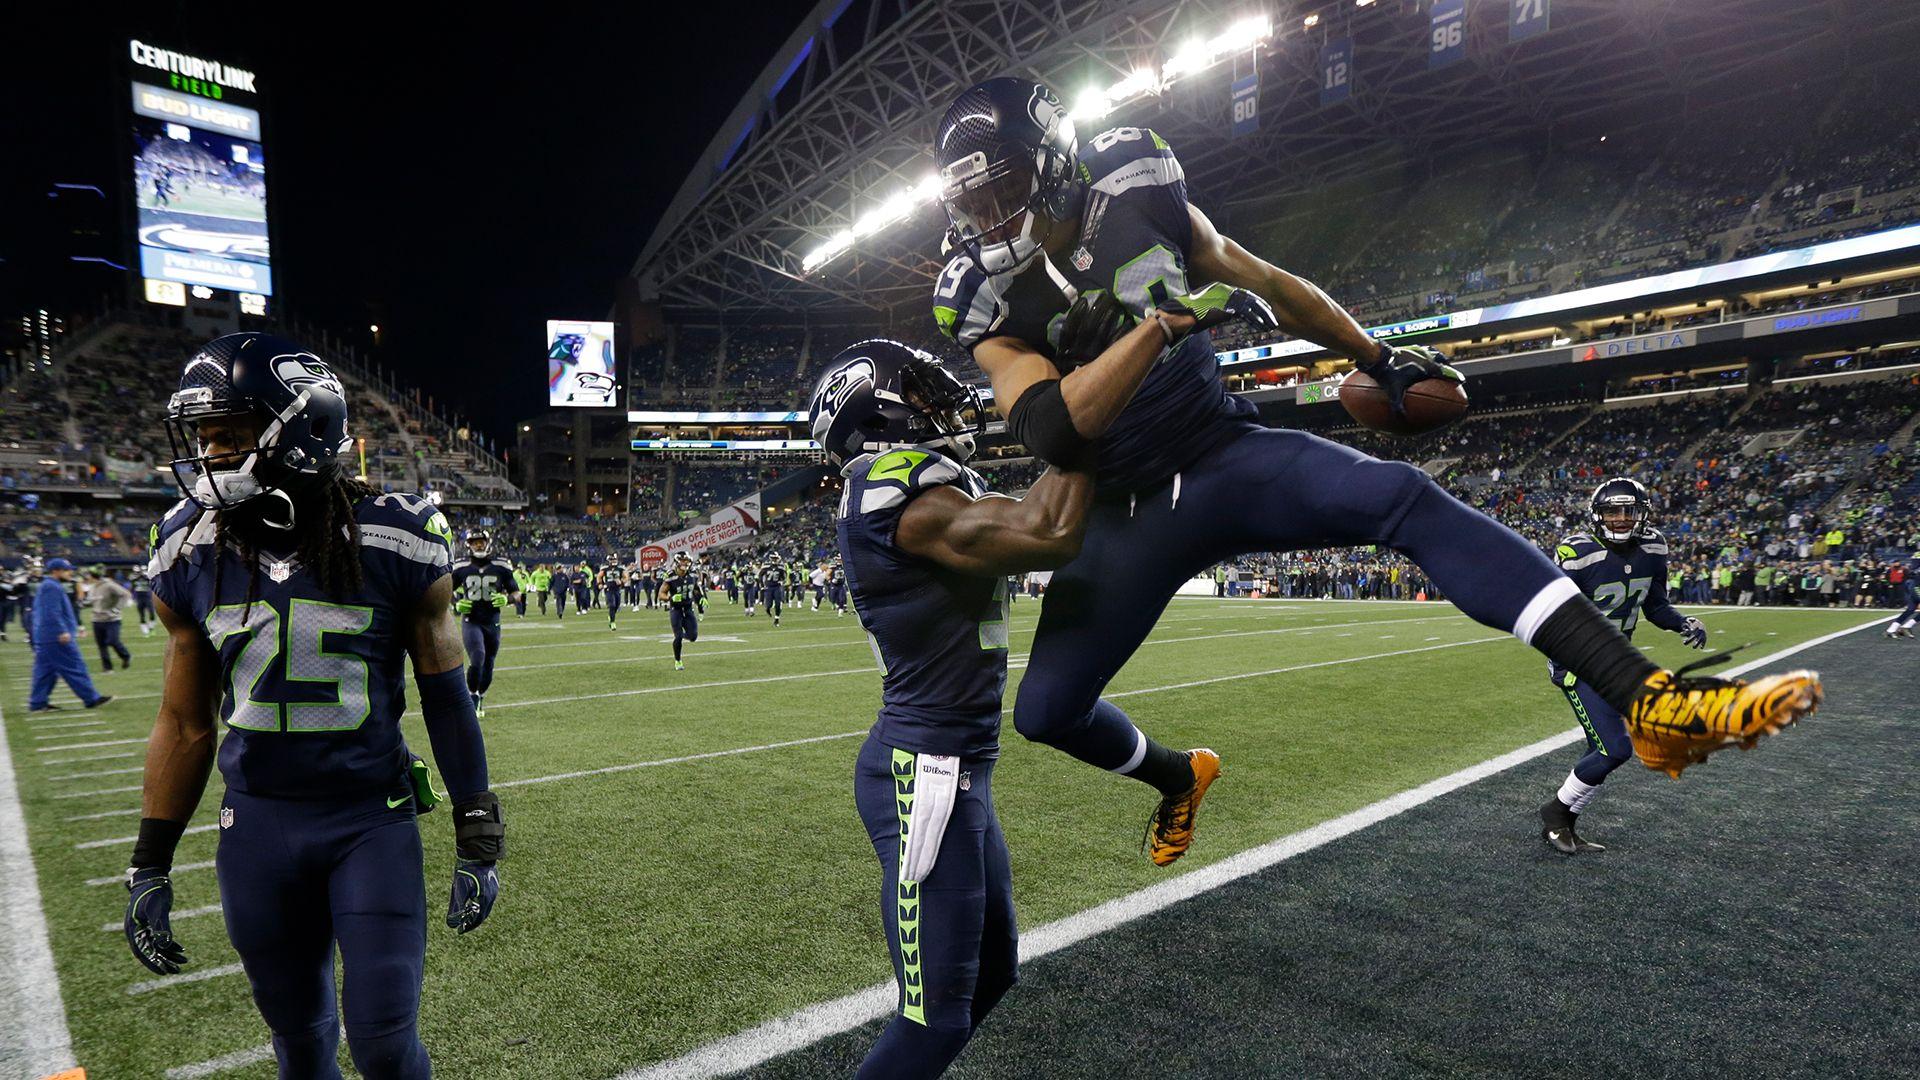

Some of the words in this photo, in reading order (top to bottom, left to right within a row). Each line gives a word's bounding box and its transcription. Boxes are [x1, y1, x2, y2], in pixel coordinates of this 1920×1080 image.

[1433, 21, 1462, 52] 96
[130, 39, 257, 94] CENTURYLINK
[1325, 62, 1347, 90] 12
[170, 73, 222, 100] FIELD
[142, 92, 190, 117] BUD
[190, 103, 252, 131] LIGHT
[1234, 97, 1256, 123] 80
[1115, 168, 1157, 184] SEAHAWKS
[1608, 334, 1684, 356] DELTA
[362, 531, 410, 547] SEAHAWKS
[667, 536, 688, 552] KICK
[688, 530, 704, 542] OFF
[706, 519, 737, 536] REDBOX
[691, 535, 717, 552] MOVIE
[465, 575, 498, 601] 86
[1593, 577, 1653, 632] 27
[205, 598, 374, 733] 25
[923, 765, 952, 777] Wilson
